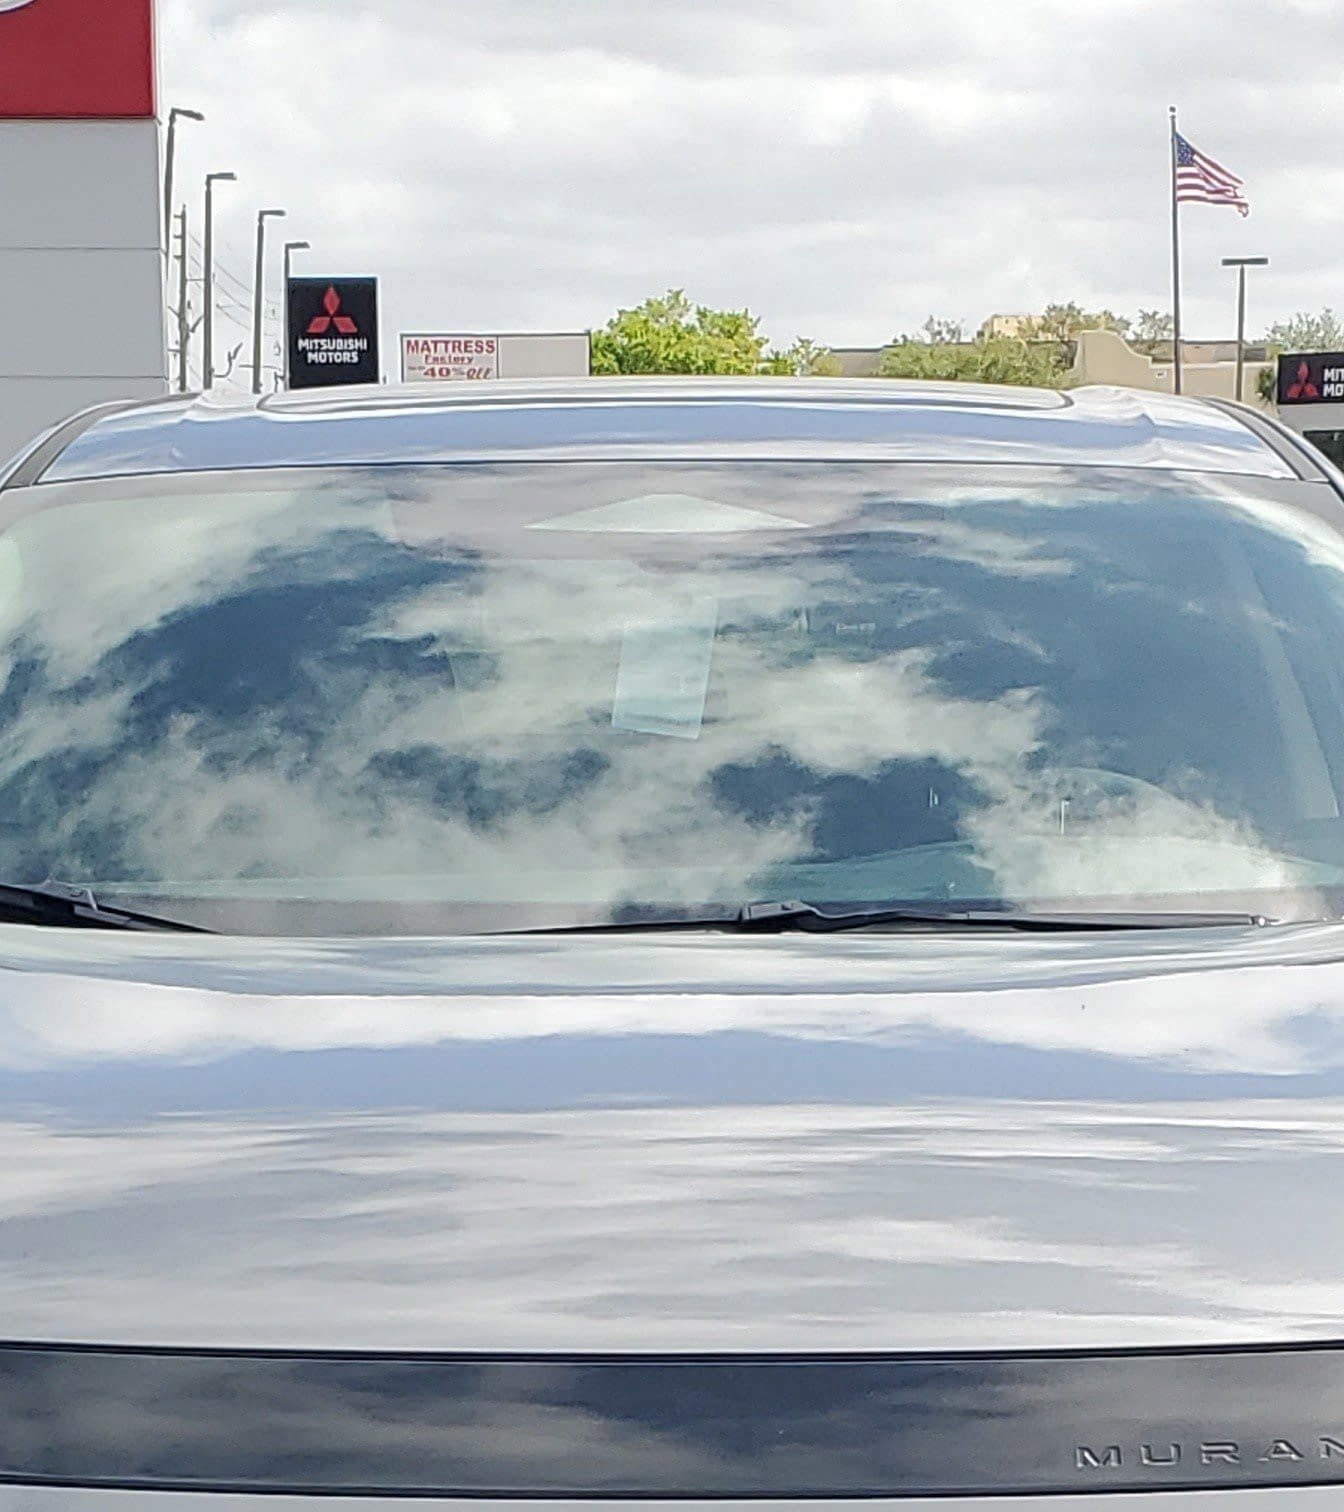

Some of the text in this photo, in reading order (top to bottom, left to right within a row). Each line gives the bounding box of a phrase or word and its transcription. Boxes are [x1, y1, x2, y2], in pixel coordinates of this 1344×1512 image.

[298, 338, 367, 351] MITSUBISHI
[406, 340, 495, 354] MATTRESS
[307, 352, 358, 363] MOTORS
